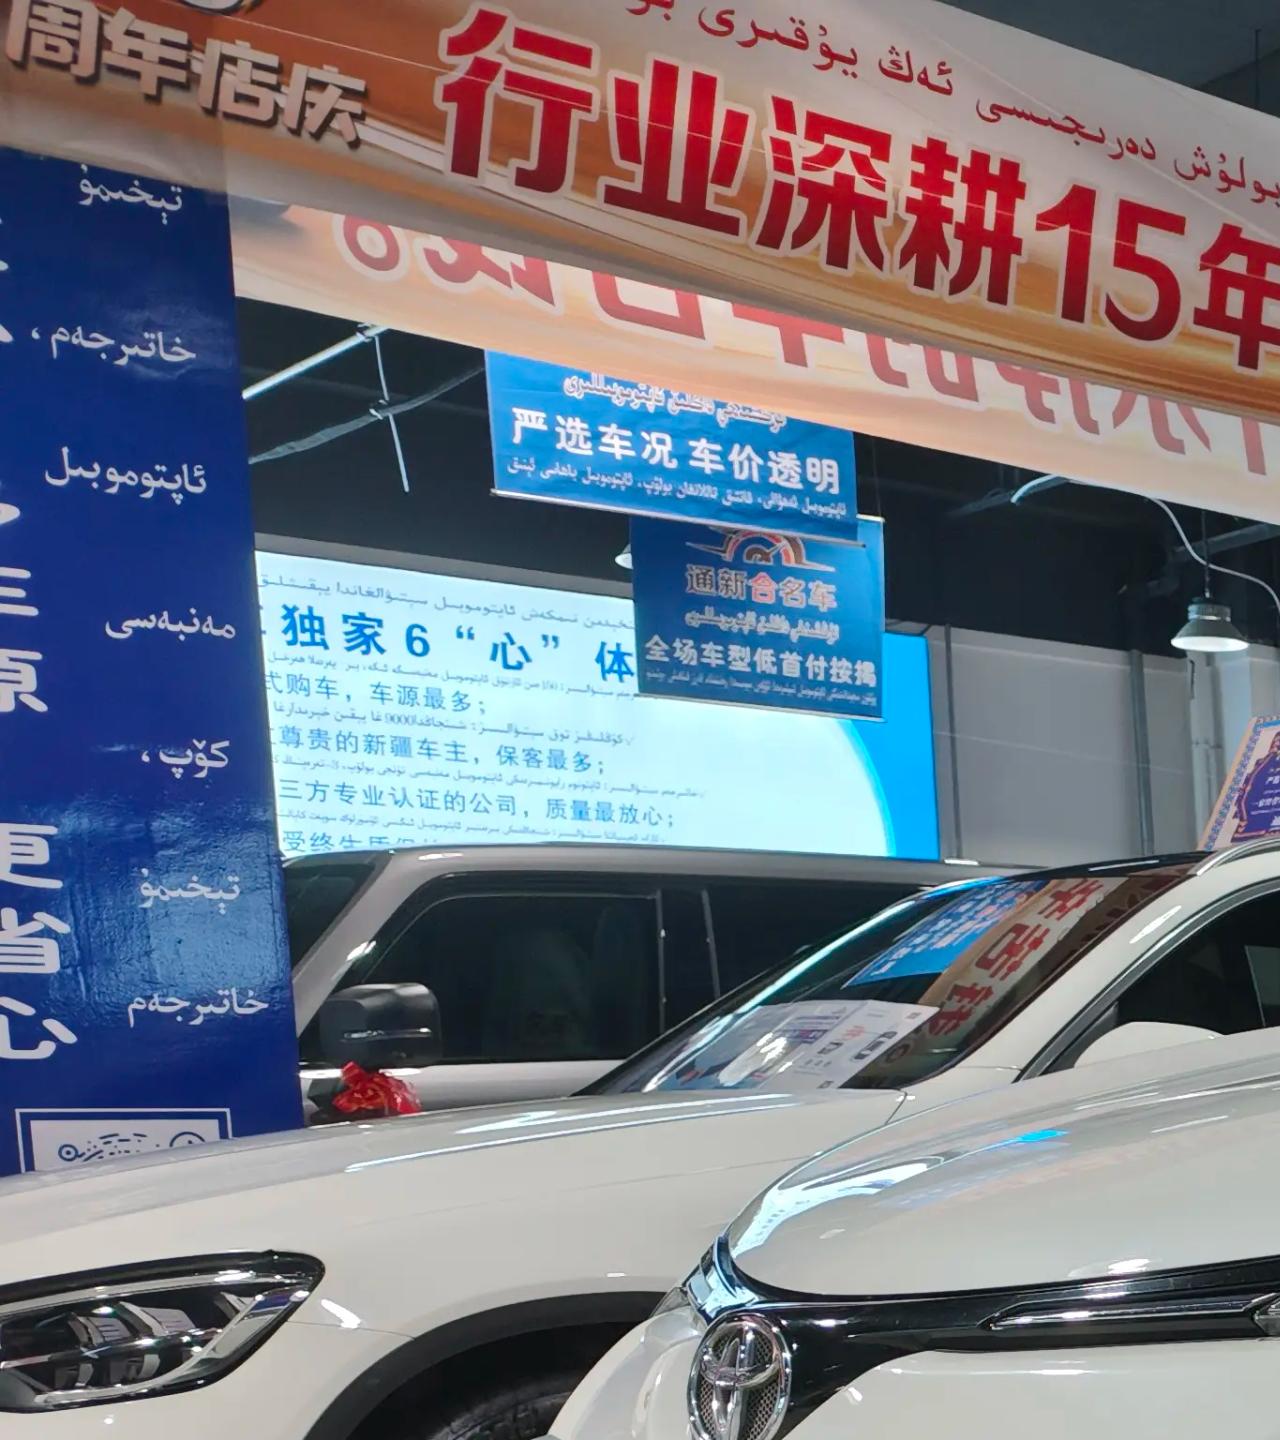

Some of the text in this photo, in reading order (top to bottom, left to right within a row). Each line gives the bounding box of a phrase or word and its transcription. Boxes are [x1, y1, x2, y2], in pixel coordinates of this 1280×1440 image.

[5, 0, 367, 146] 周年店庆
[511, 407, 840, 495] 严选车况 车价透明
[685, 564, 838, 613] 通新合名车
[644, 633, 878, 688] 全场车型低首付按揭
[270, 725, 604, 775] 尊贵的新疆车主，保客最多；
